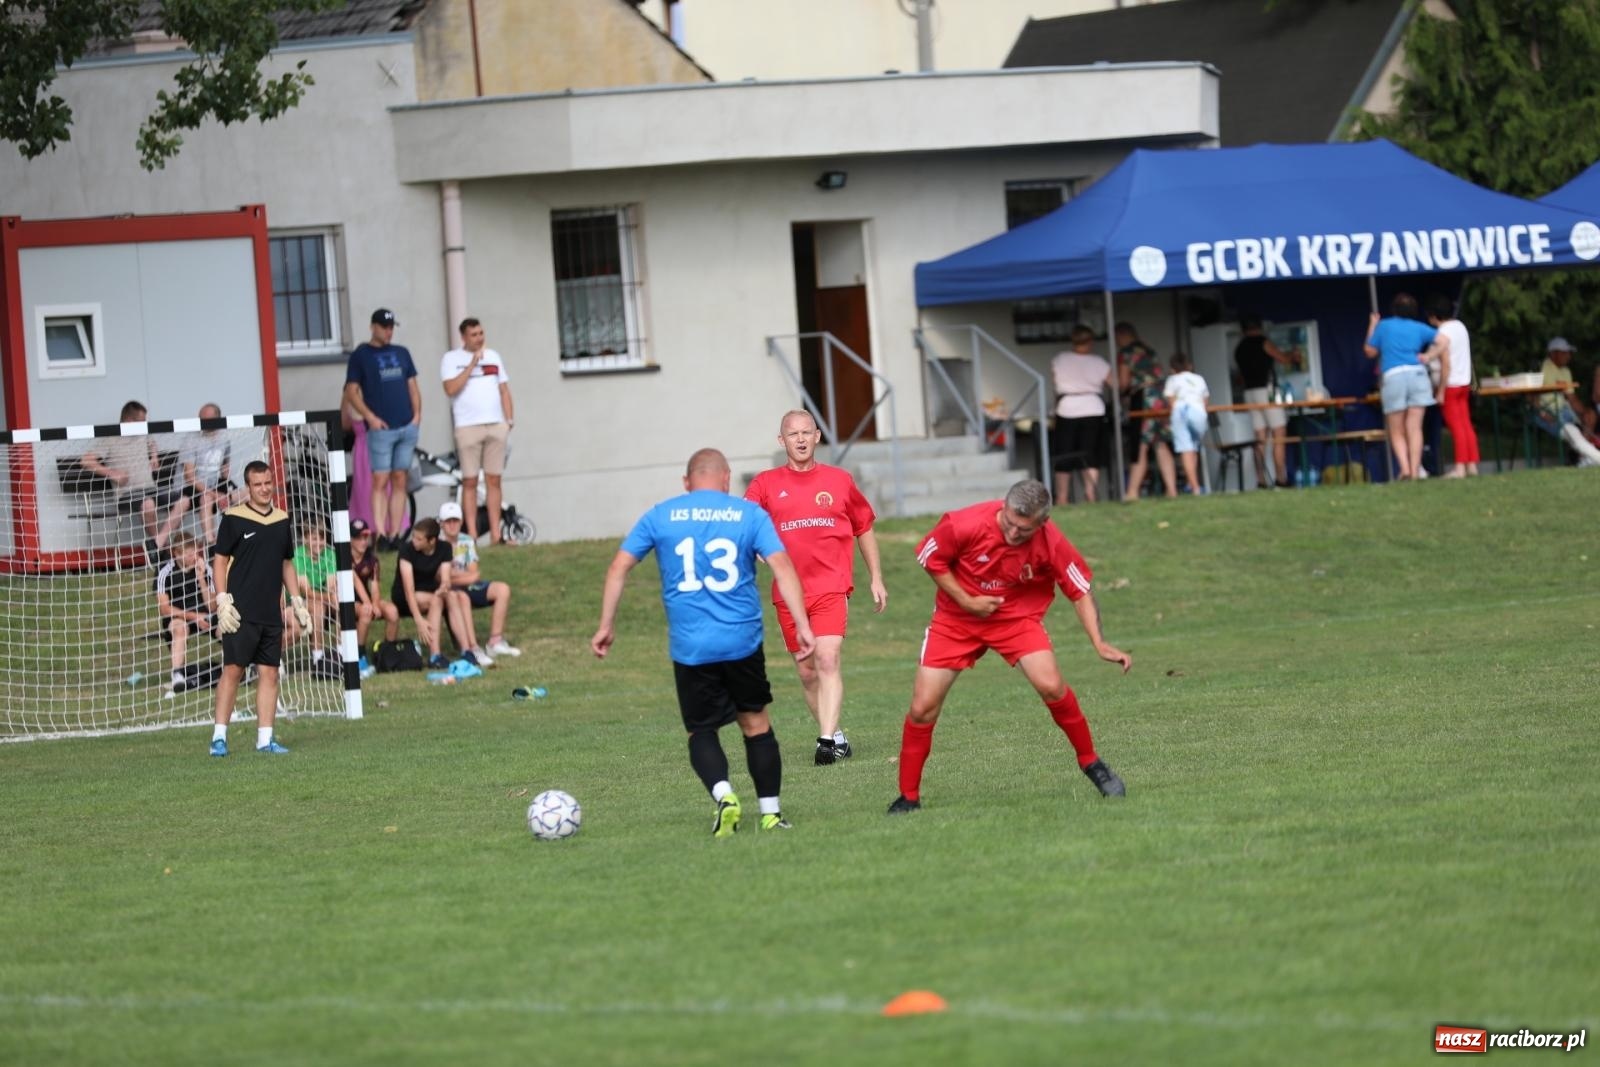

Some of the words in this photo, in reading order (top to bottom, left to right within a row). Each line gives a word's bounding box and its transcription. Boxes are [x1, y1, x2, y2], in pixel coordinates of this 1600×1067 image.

[1186, 235, 1292, 283] GCBK
[1298, 224, 1553, 276] KRZANOWICE
[671, 508, 689, 521] LKS
[674, 536, 740, 593] 13
